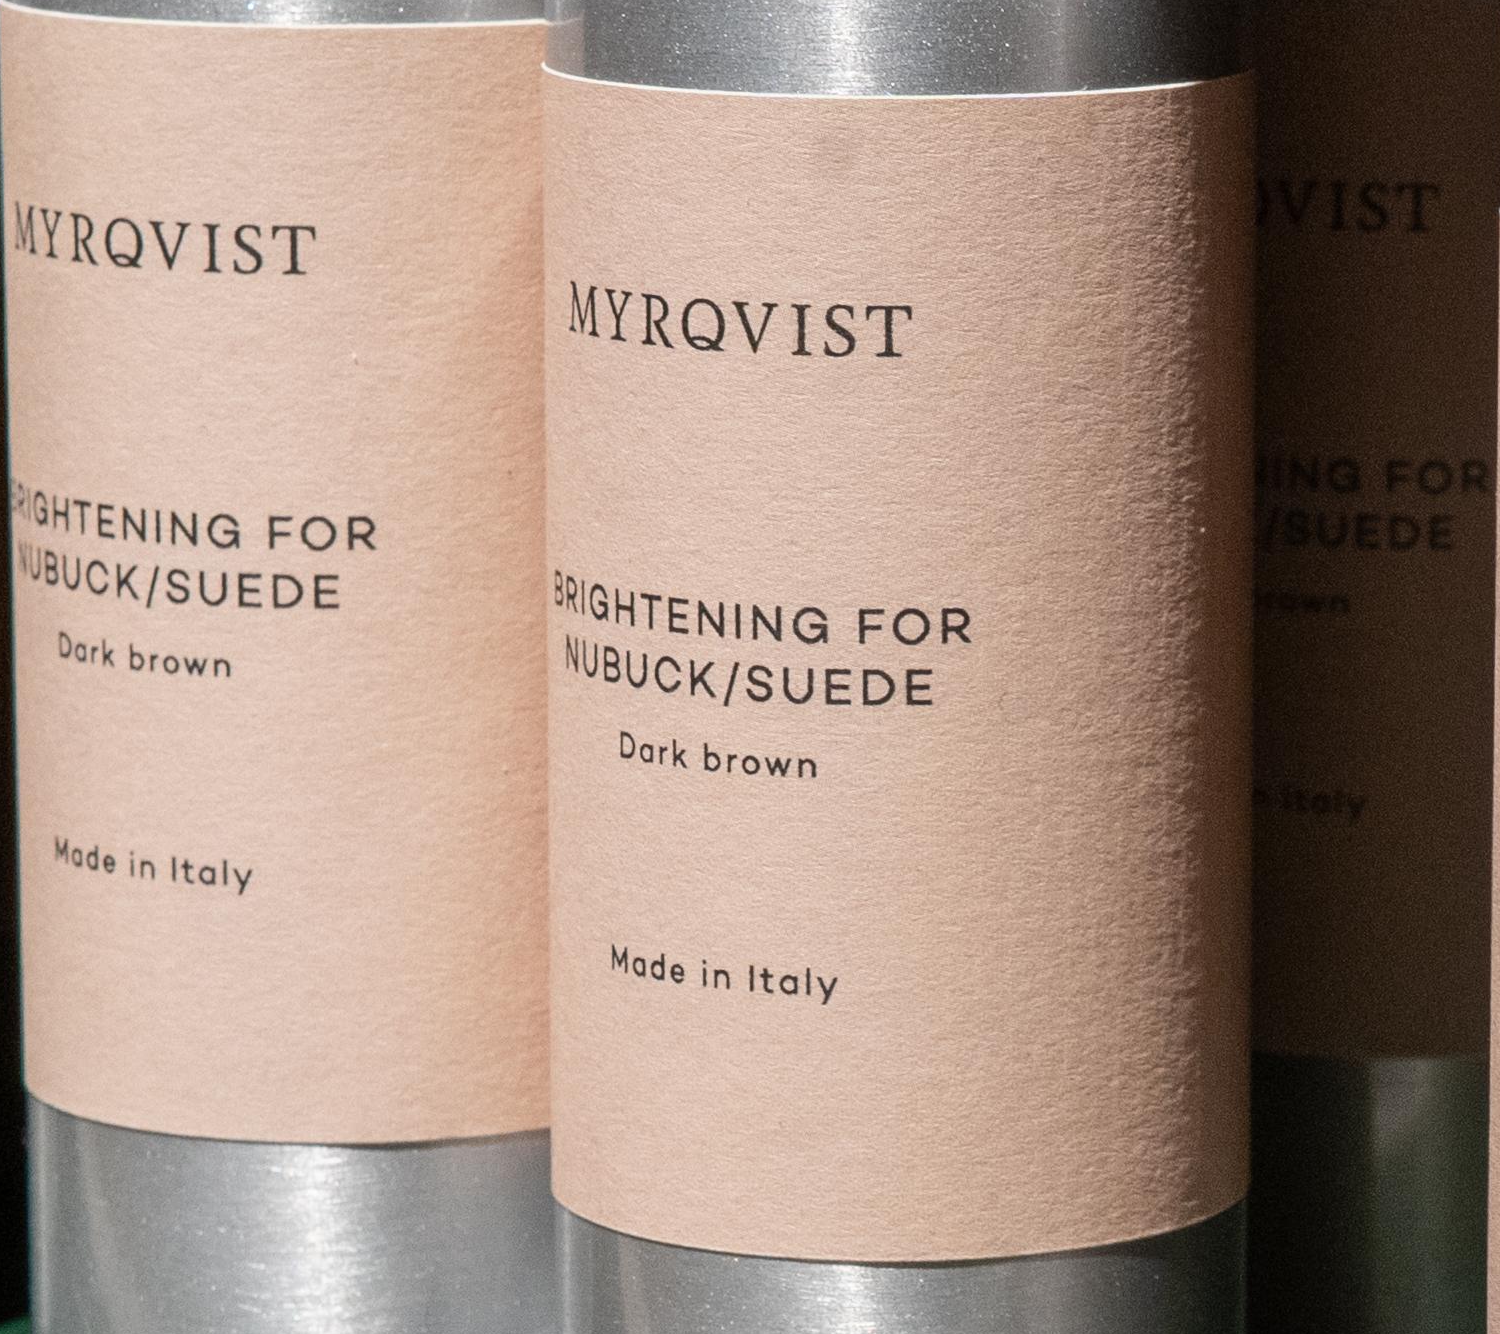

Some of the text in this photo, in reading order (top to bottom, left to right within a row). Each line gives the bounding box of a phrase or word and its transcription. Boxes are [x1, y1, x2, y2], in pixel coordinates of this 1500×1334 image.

[13, 200, 317, 276] MYRQVIST
[568, 279, 914, 358] MYRQVIST
[267, 514, 378, 552] FOR
[17, 538, 342, 610] NUBUCK/SUEDE
[553, 568, 973, 646] BRIGHTENING FOR
[57, 630, 233, 679] Dark brown
[564, 633, 935, 708] NUBUCK/SUEDE
[618, 729, 819, 779] Dark brown
[54, 834, 254, 897] Made in Italy
[610, 942, 839, 1006] Made in Italy
